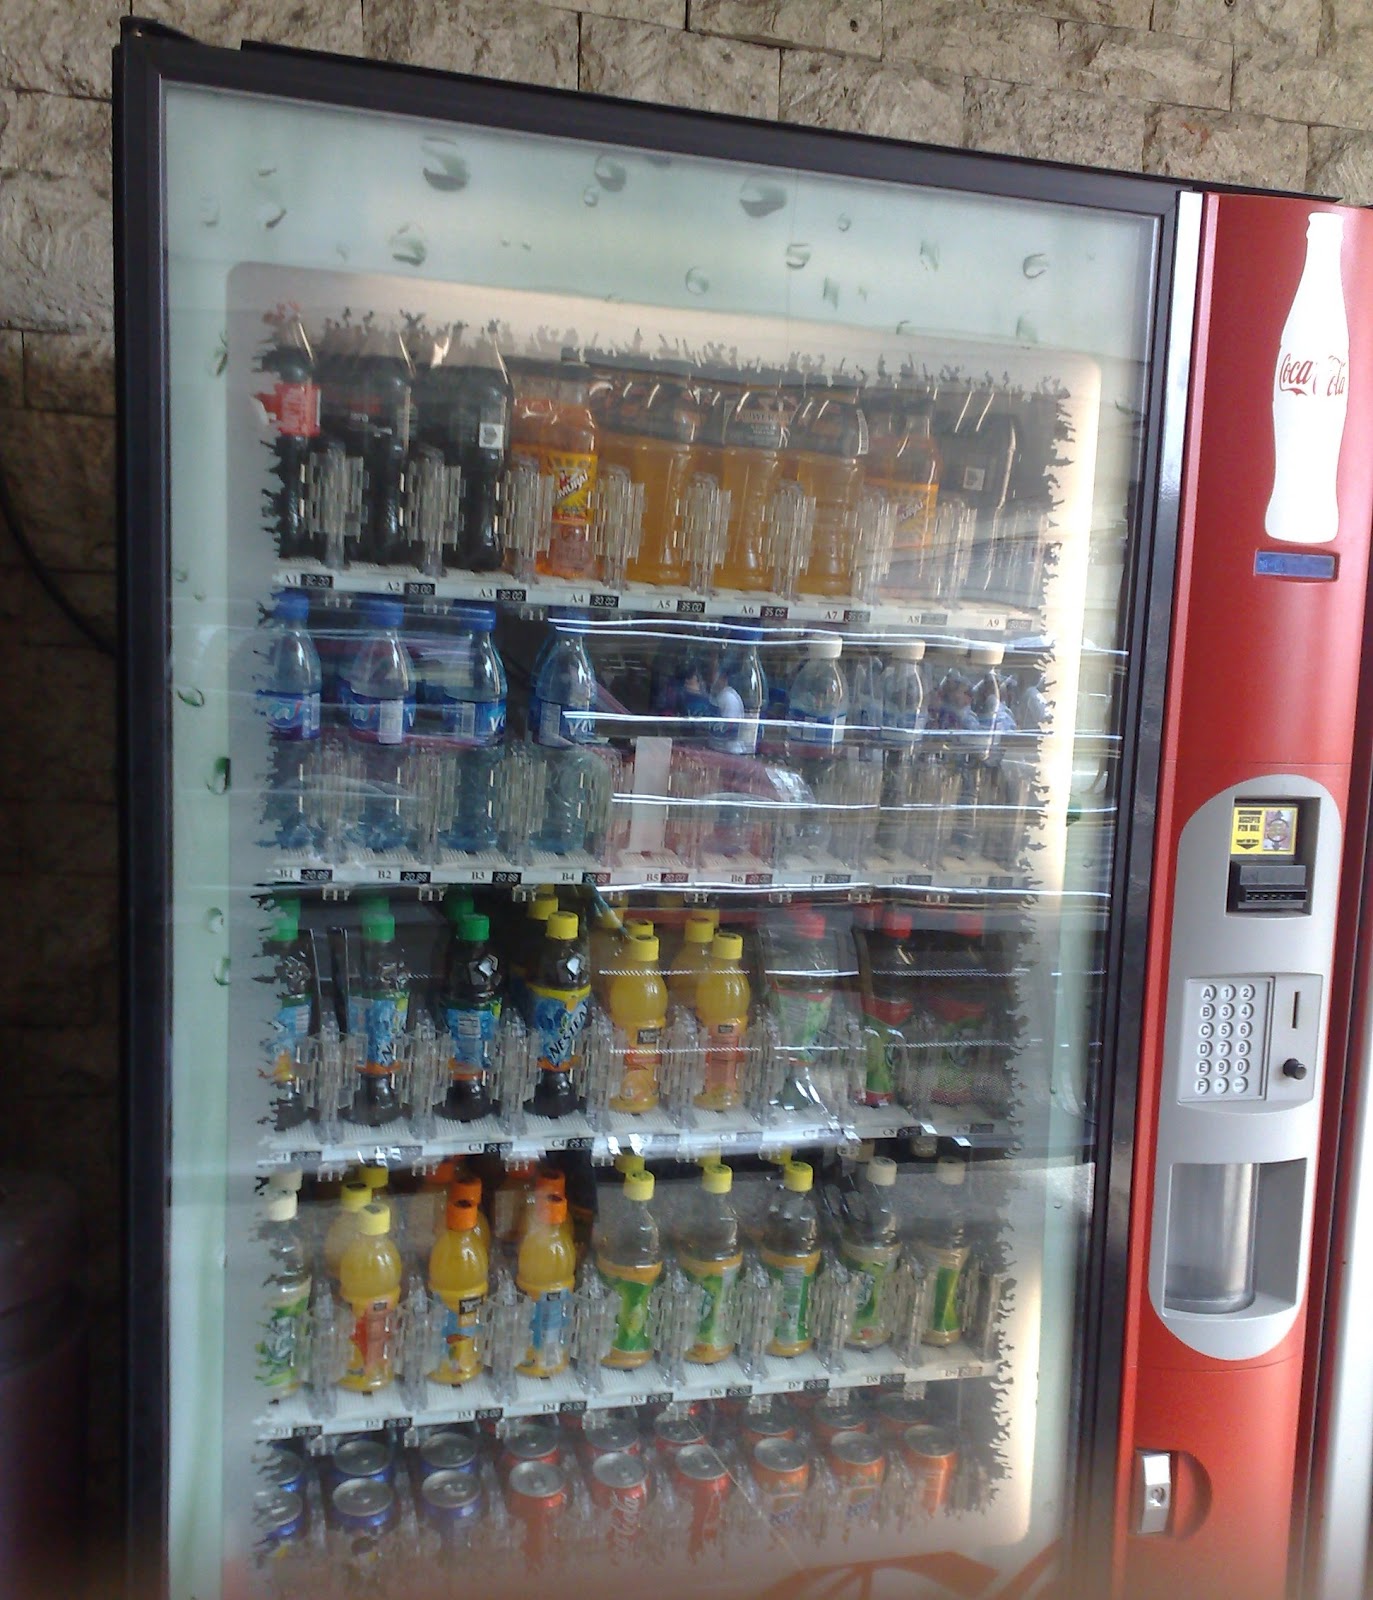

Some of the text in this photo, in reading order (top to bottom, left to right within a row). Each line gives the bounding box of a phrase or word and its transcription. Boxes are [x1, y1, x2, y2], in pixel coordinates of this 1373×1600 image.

[387, 582, 400, 591] A2
[480, 589, 493, 598] A3
[571, 594, 584, 602] A4
[657, 601, 670, 609] A5
[741, 605, 754, 614] A6
[824, 611, 837, 619] A7
[907, 616, 920, 624] A8
[987, 619, 1000, 627] A9
[279, 870, 293, 878] B1
[378, 870, 391, 879] B2
[471, 872, 484, 880] B3
[562, 873, 575, 881] B4
[646, 874, 659, 882] B5
[731, 874, 743, 882] B6
[811, 875, 823, 883] B7
[1203, 988, 1249, 998] A 1 2
[1202, 1006, 1248, 1017] B 3 4
[1201, 1025, 1246, 1036] C 5 6
[1200, 1043, 1245, 1054] D 7 8
[1199, 1061, 1244, 1072] E 9 0
[1197, 1081, 1204, 1090] F
